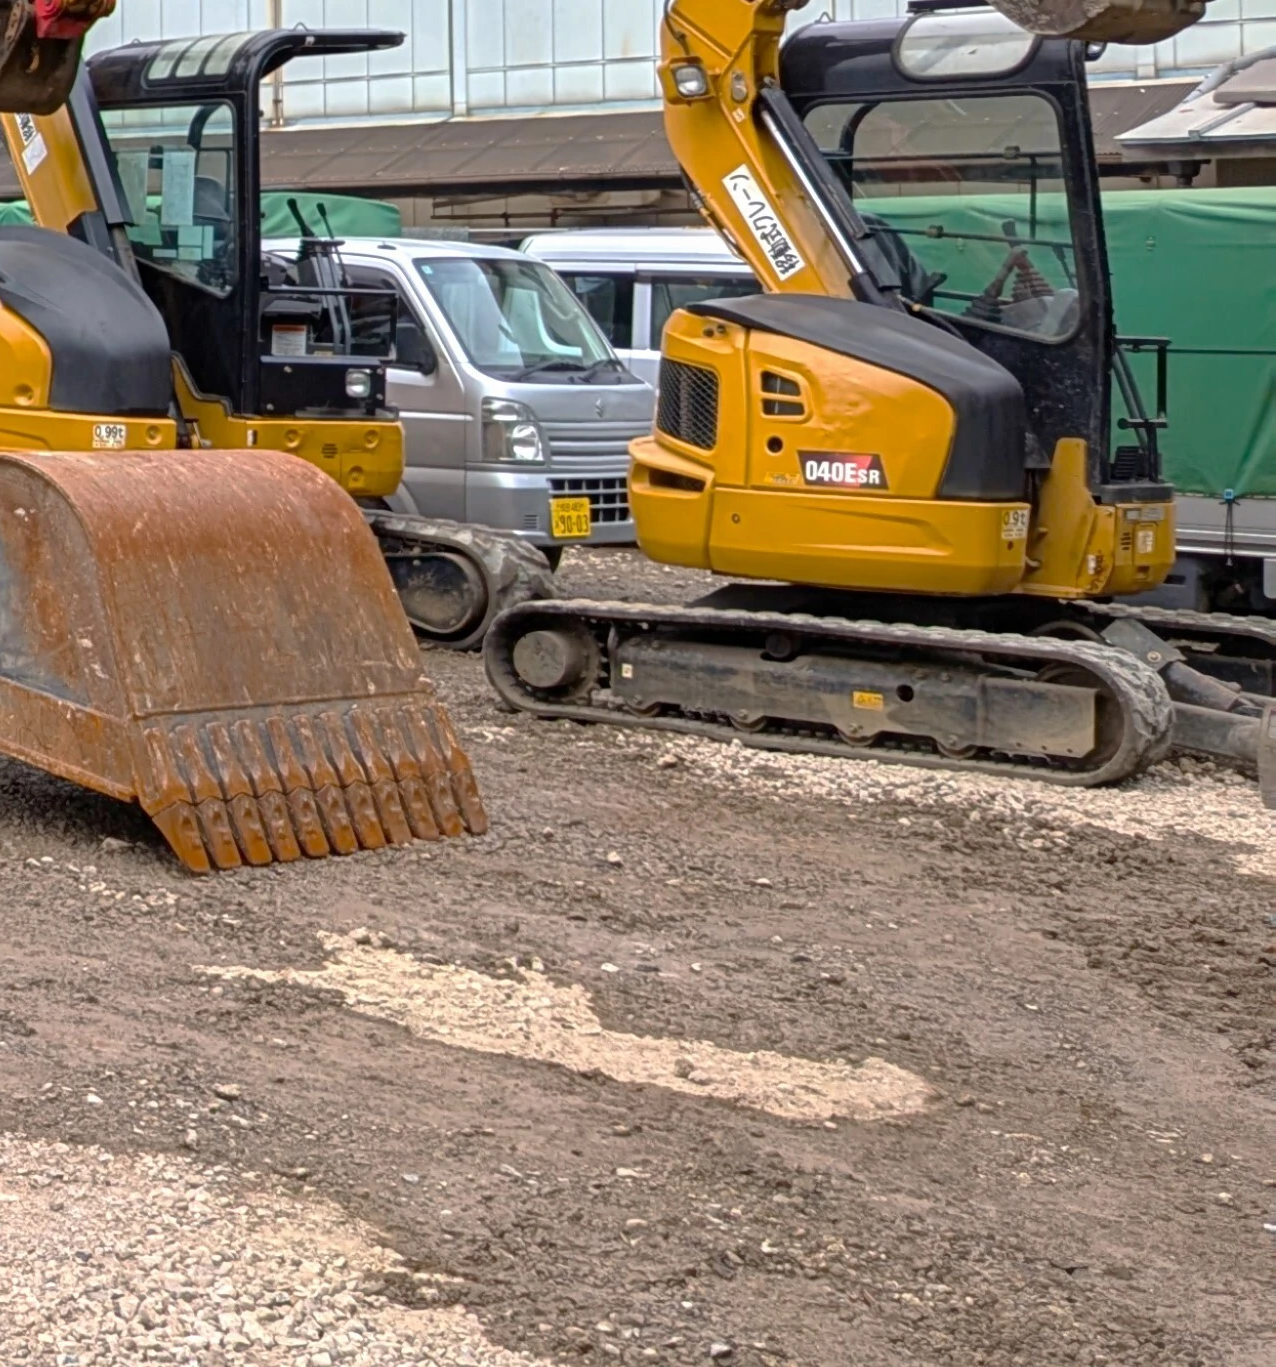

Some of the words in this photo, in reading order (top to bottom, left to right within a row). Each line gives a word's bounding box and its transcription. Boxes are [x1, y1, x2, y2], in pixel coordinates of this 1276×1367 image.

[729, 173, 800, 275] 移動式クレーン
[805, 460, 880, 485] 040ESR
